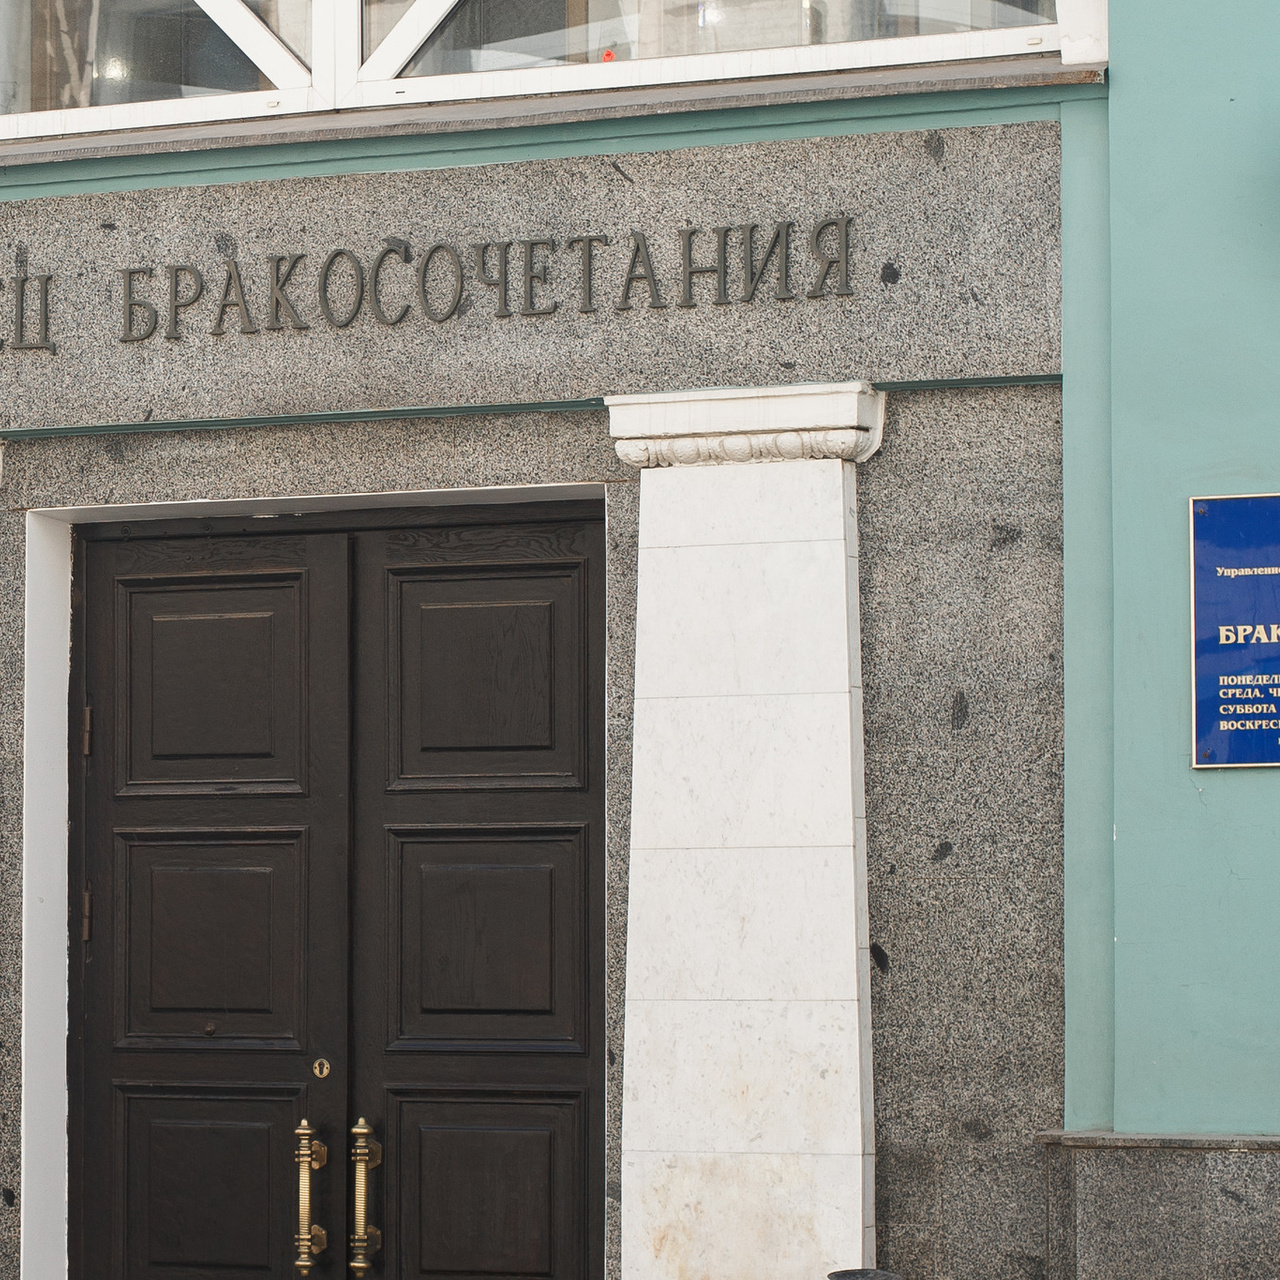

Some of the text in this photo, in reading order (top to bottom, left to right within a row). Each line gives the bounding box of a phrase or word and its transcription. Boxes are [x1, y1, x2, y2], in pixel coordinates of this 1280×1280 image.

[120, 217, 854, 343] БРАКОСОЧЕТАНИЯ
[1219, 674, 1280, 686] ПОНЕДЕЛ
[1219, 688, 1264, 699] СРЕДА,
[1219, 704, 1277, 715] СУББОТА
[1219, 719, 1280, 731] ВОСКРЕС
